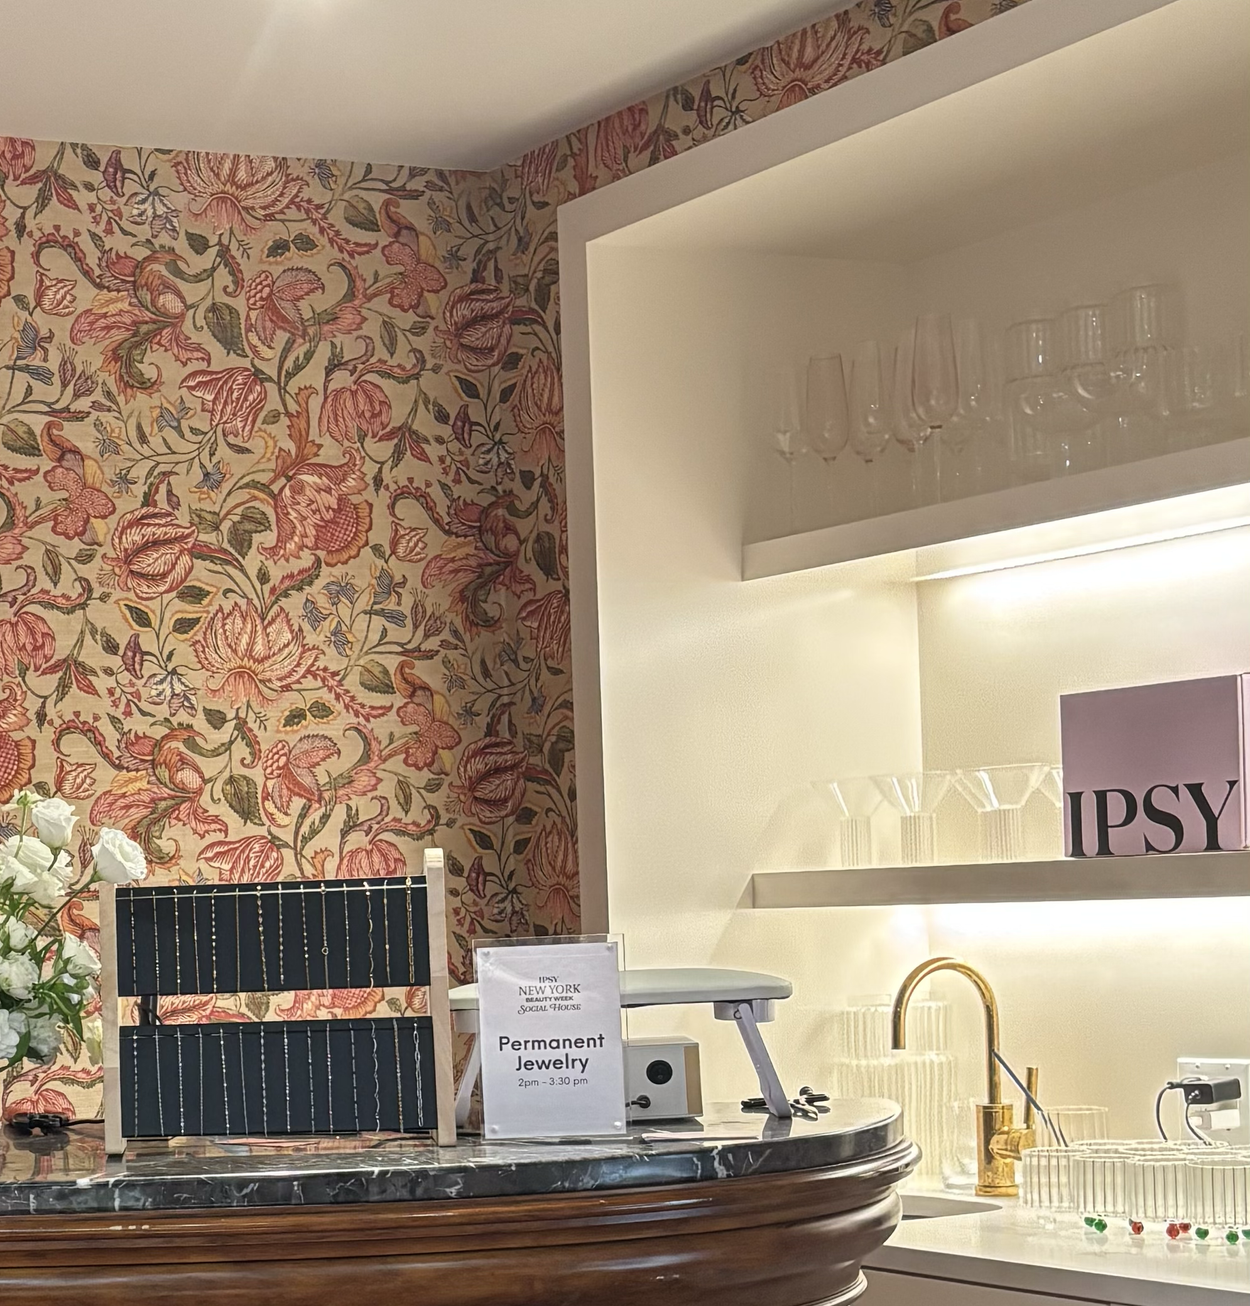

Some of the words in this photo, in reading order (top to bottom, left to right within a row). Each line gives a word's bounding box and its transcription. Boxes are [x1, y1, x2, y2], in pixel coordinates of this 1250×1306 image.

[1066, 779, 1239, 857] IPSY
[538, 975, 559, 984] IPSY
[518, 985, 547, 996] NEW
[548, 983, 581, 995] YORK
[498, 1033, 605, 1052] Permanent
[515, 1052, 589, 1074] Jewelry
[517, 1078, 540, 1089] 2pm
[548, 1076, 571, 1086] 3:30
[573, 1077, 589, 1087] pm
